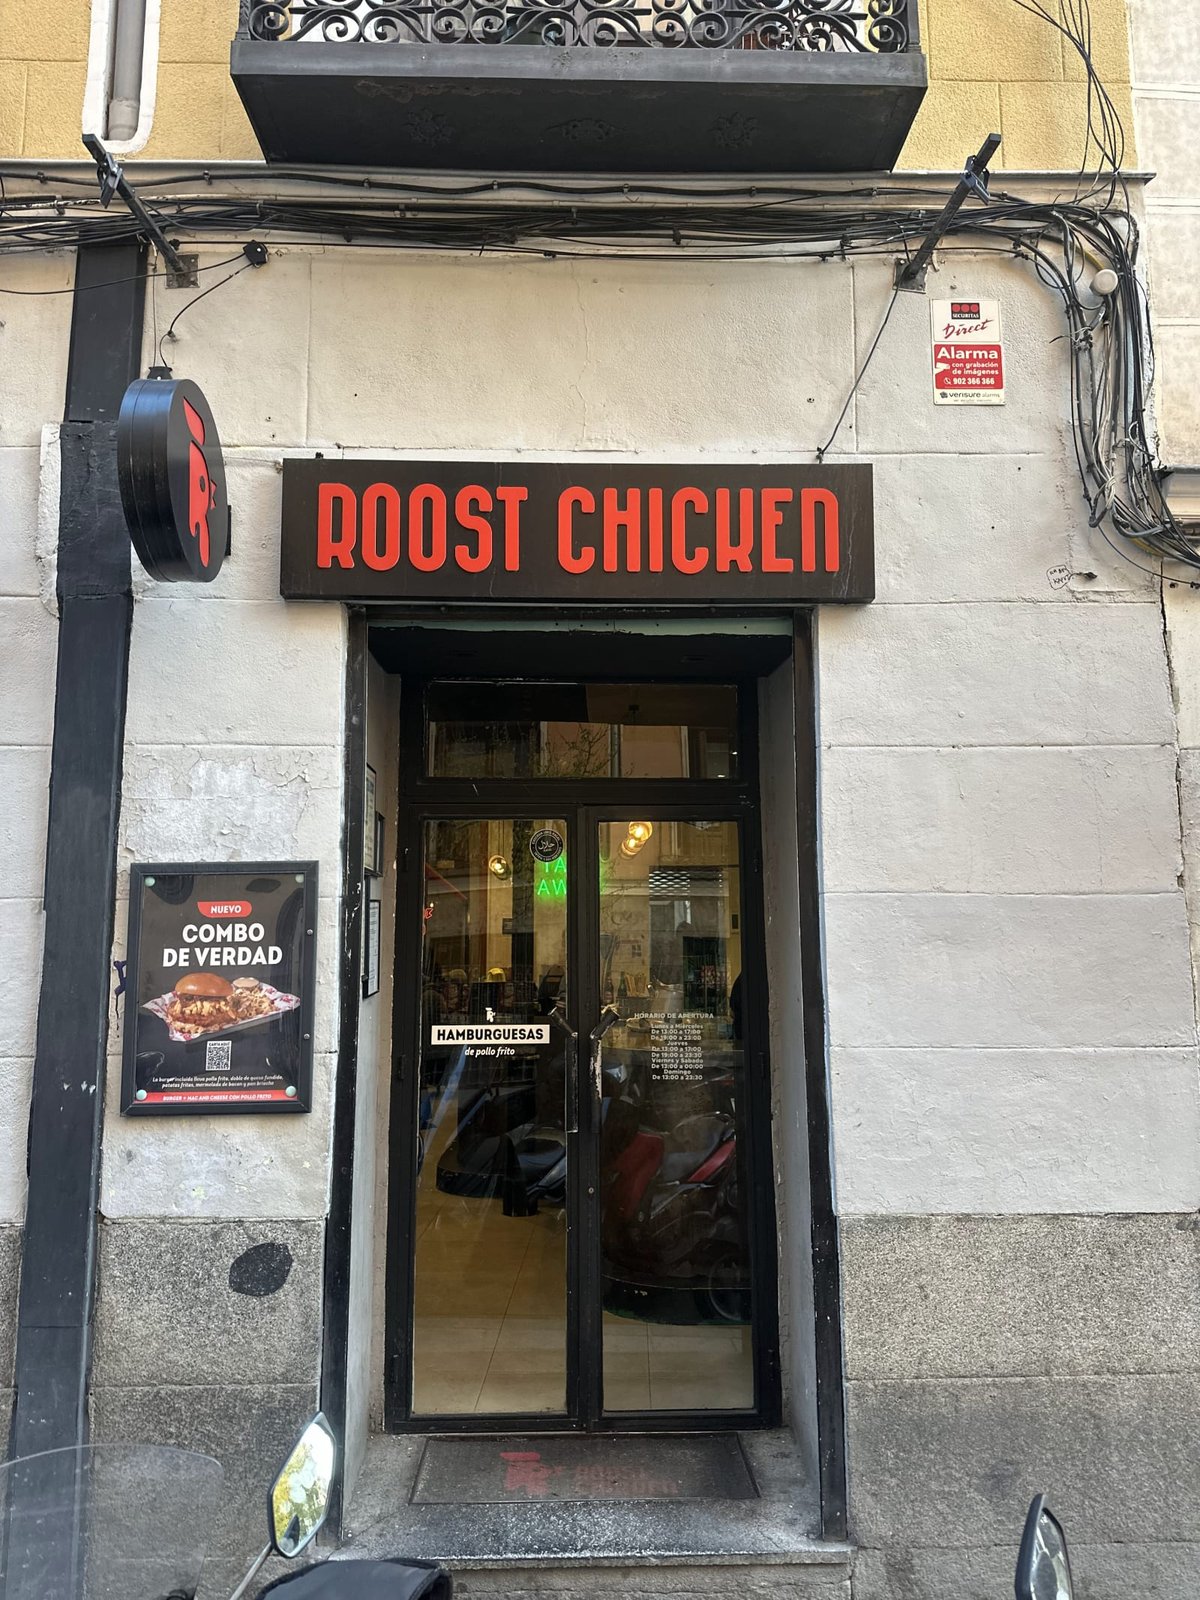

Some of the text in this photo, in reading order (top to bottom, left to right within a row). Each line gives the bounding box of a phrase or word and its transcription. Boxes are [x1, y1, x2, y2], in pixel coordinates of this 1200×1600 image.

[942, 319, 994, 339] Direct
[937, 346, 998, 359] Alarma
[953, 377, 995, 385] 902 366 366
[317, 482, 840, 575] ROOST CHICKEN
[210, 905, 242, 914] NUEVO
[182, 923, 265, 943] COMBO
[162, 946, 283, 967] DE VERDAD
[437, 1028, 544, 1041] HAMBURGUESAS
[464, 1046, 516, 1058] de pollo frito
